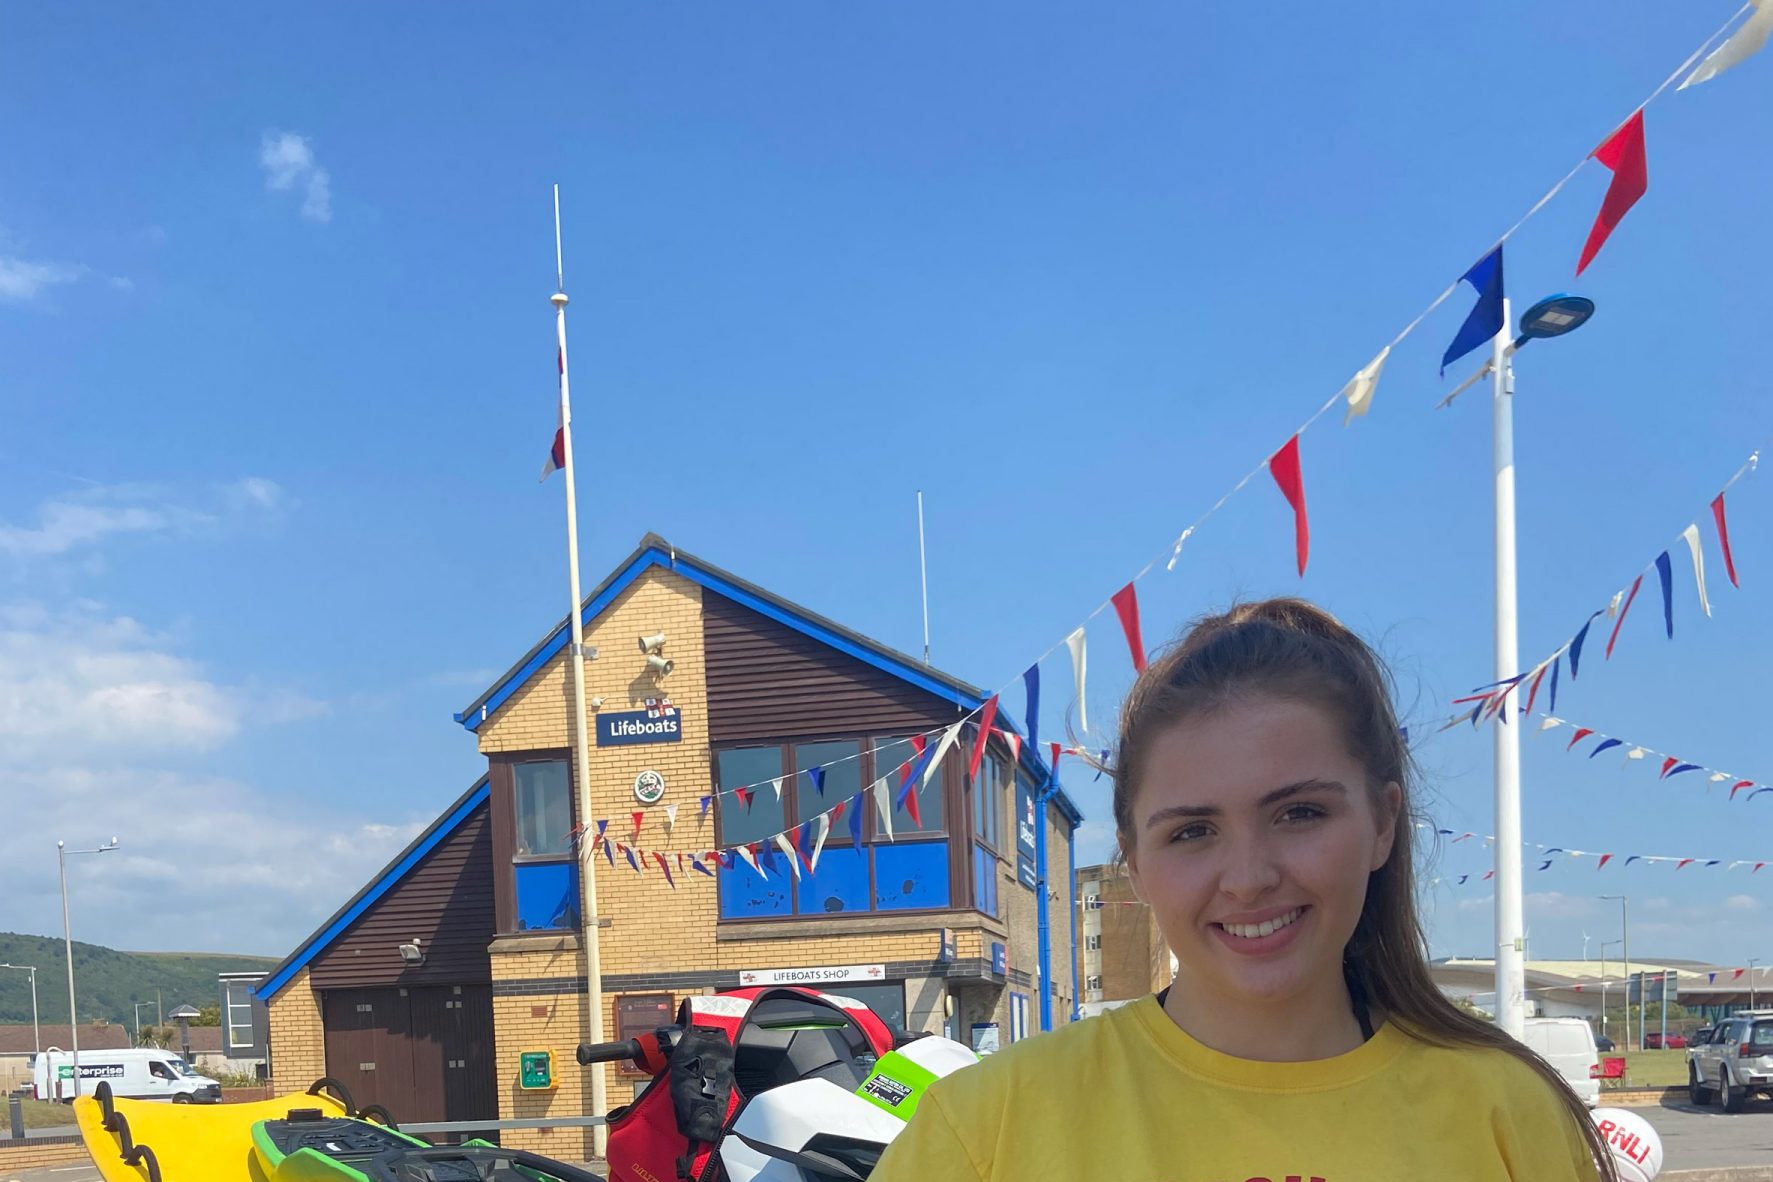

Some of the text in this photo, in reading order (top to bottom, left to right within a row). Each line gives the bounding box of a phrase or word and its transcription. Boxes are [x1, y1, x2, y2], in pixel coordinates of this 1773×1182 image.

[611, 719, 678, 736] Lifeboats
[773, 969, 850, 981] LIFEBOATS SHOP
[1598, 1119, 1651, 1165] RNLI
